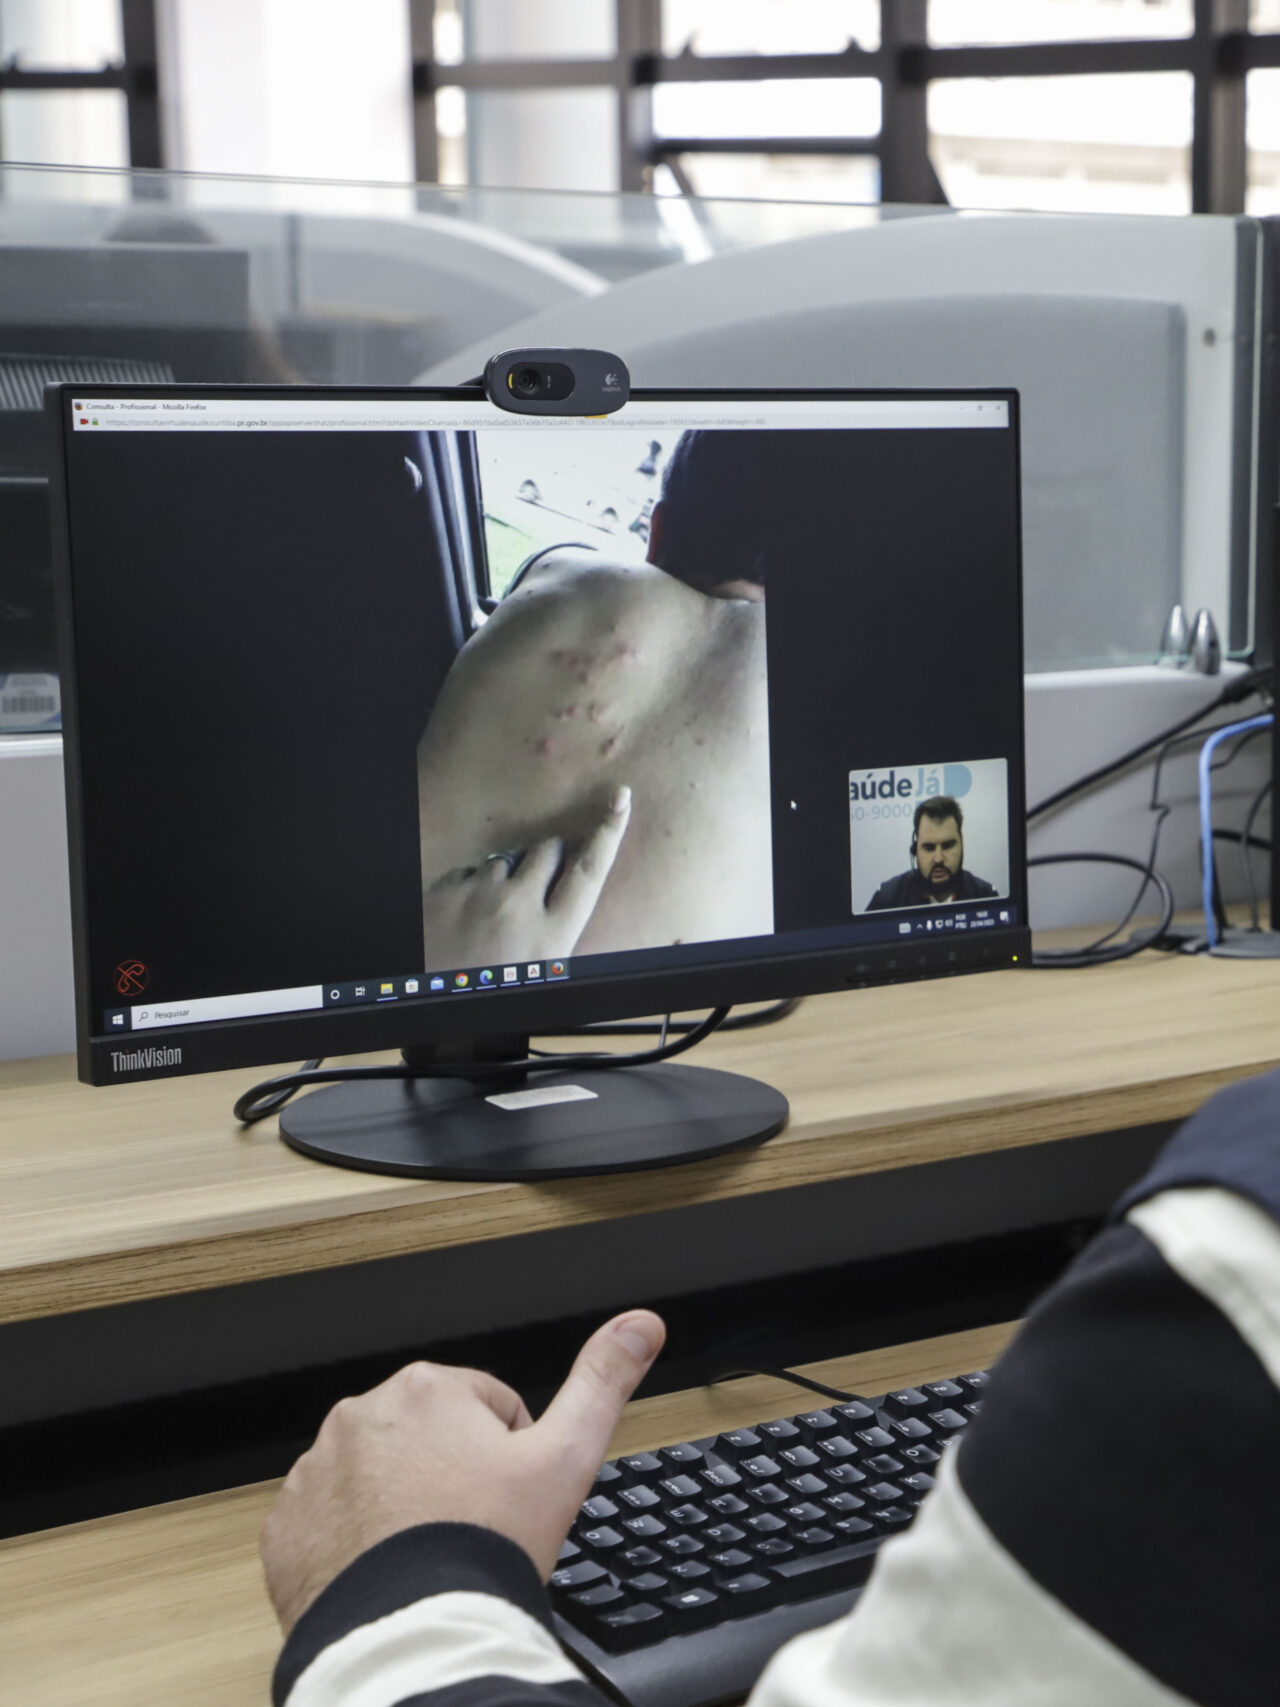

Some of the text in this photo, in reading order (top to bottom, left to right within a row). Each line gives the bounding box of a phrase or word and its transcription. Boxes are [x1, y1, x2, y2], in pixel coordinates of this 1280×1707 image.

[915, 767, 940, 798] Já
[154, 1008, 190, 1020] Pesquisar
[111, 1046, 182, 1073] ThinkVision
